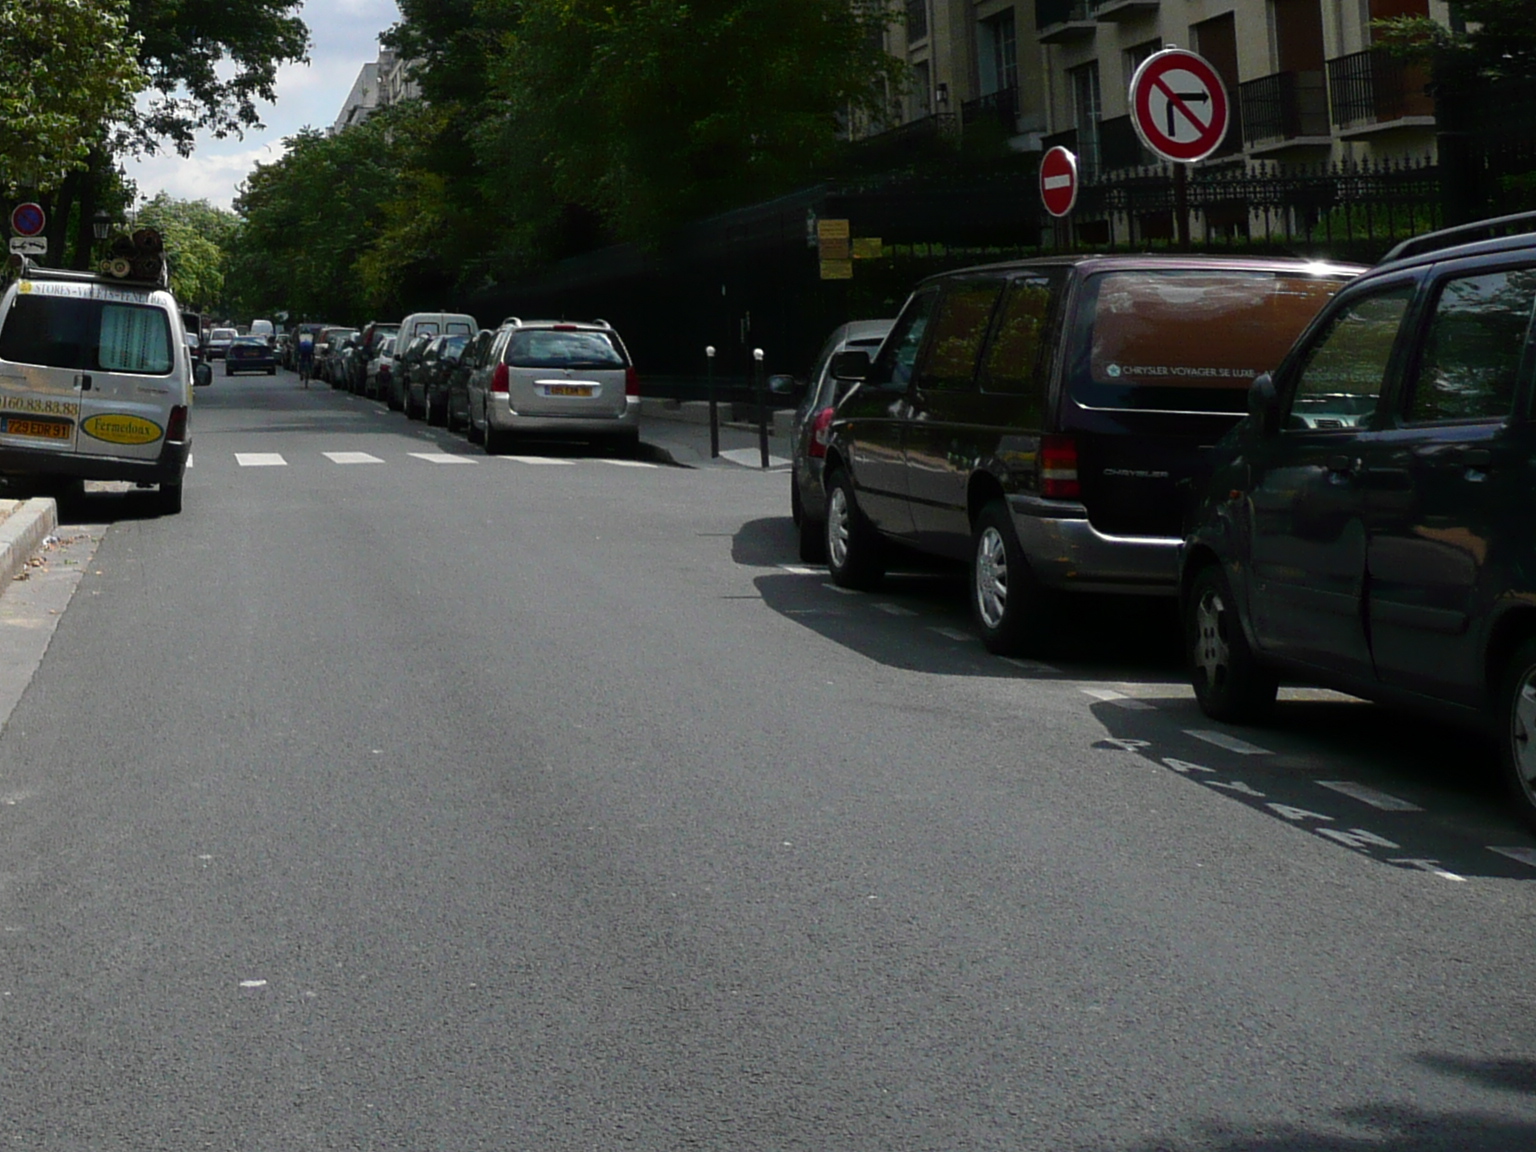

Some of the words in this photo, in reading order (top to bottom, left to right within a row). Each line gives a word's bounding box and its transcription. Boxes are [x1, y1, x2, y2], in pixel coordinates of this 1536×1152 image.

[1122, 365, 1169, 376] CHRYSLER
[1170, 366, 1217, 377] VOYAGER
[8, 419, 29, 433] 729
[31, 421, 51, 435] EDR
[53, 423, 66, 437] 91
[1103, 468, 1170, 478] CHRYSLER
[1102, 737, 1467, 882] PAYANT
